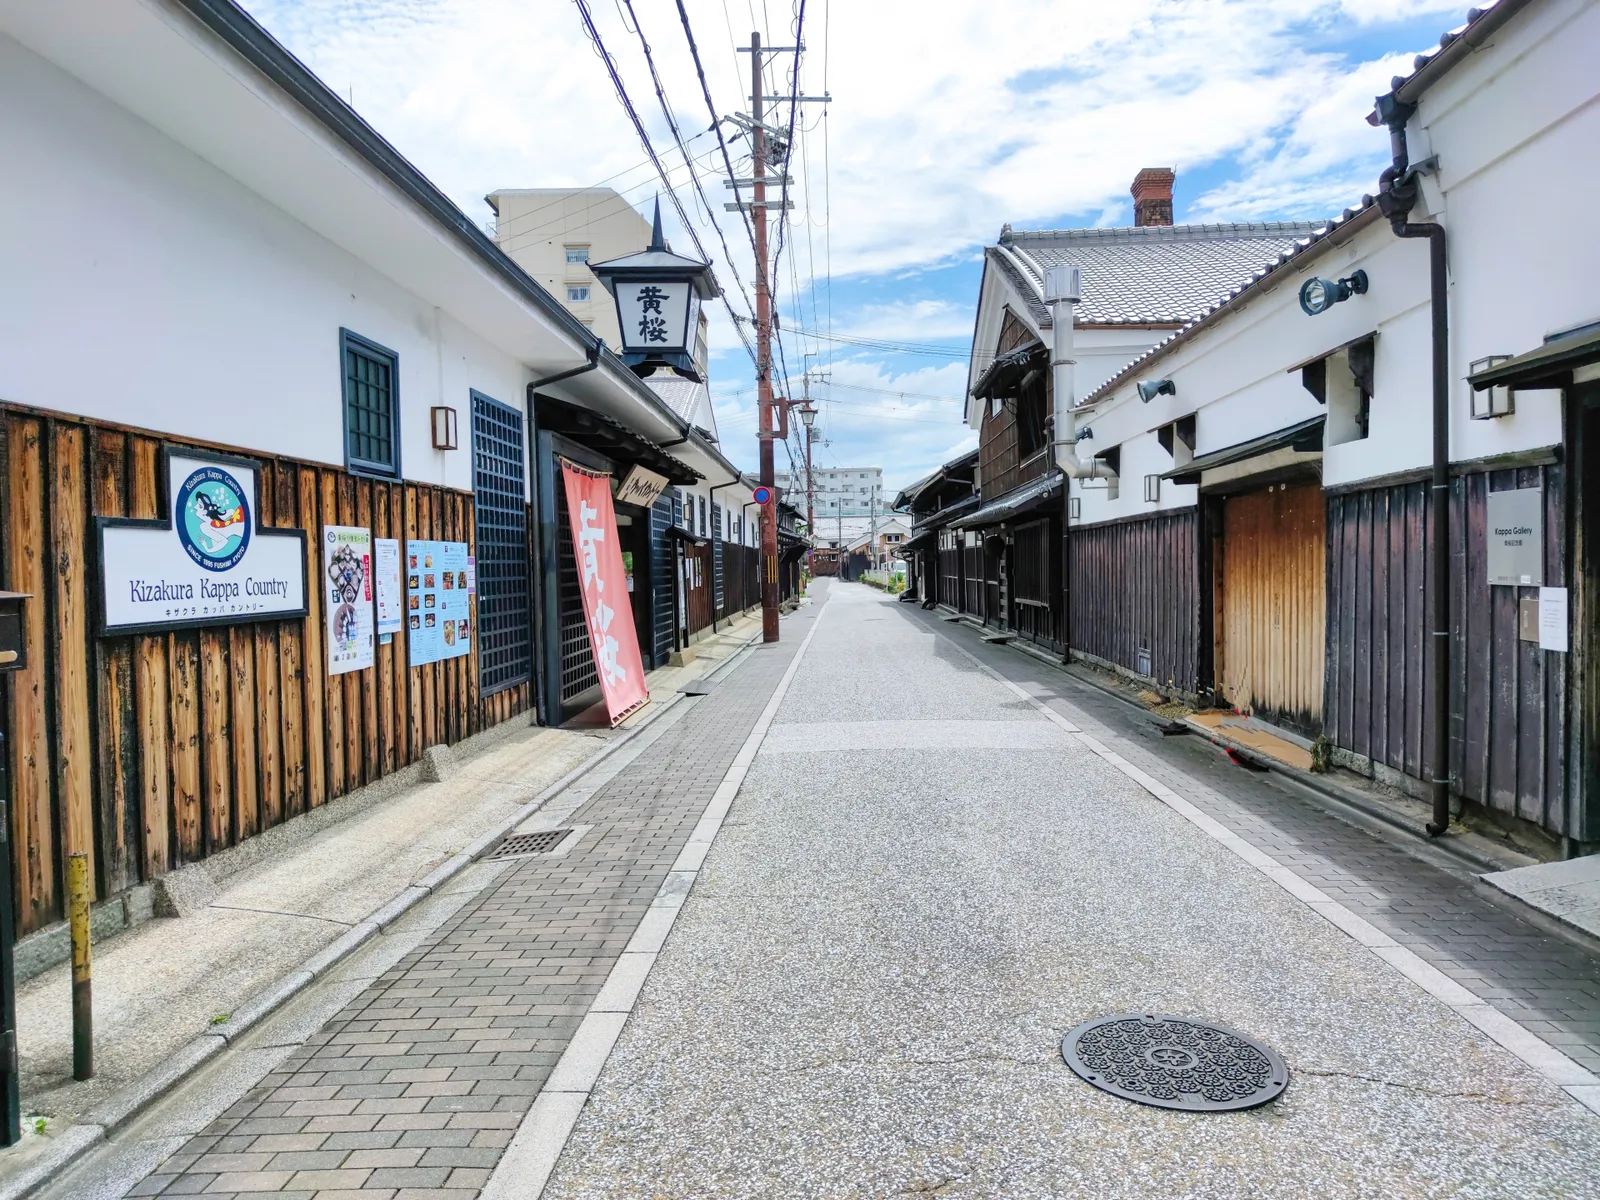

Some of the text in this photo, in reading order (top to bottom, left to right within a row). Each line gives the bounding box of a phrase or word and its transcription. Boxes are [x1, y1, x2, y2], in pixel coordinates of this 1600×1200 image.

[637, 286, 670, 344] 黄桜
[186, 470, 241, 496] Kizakura Kappa Country
[1494, 527, 1532, 536] Kappa Gallery
[187, 544, 202, 562] SINCE
[232, 546, 245, 563] KYOTO
[130, 577, 288, 602] Kizakura Kappa Country
[165, 606, 196, 617] キザクラ
[230, 603, 264, 612] カントリー
